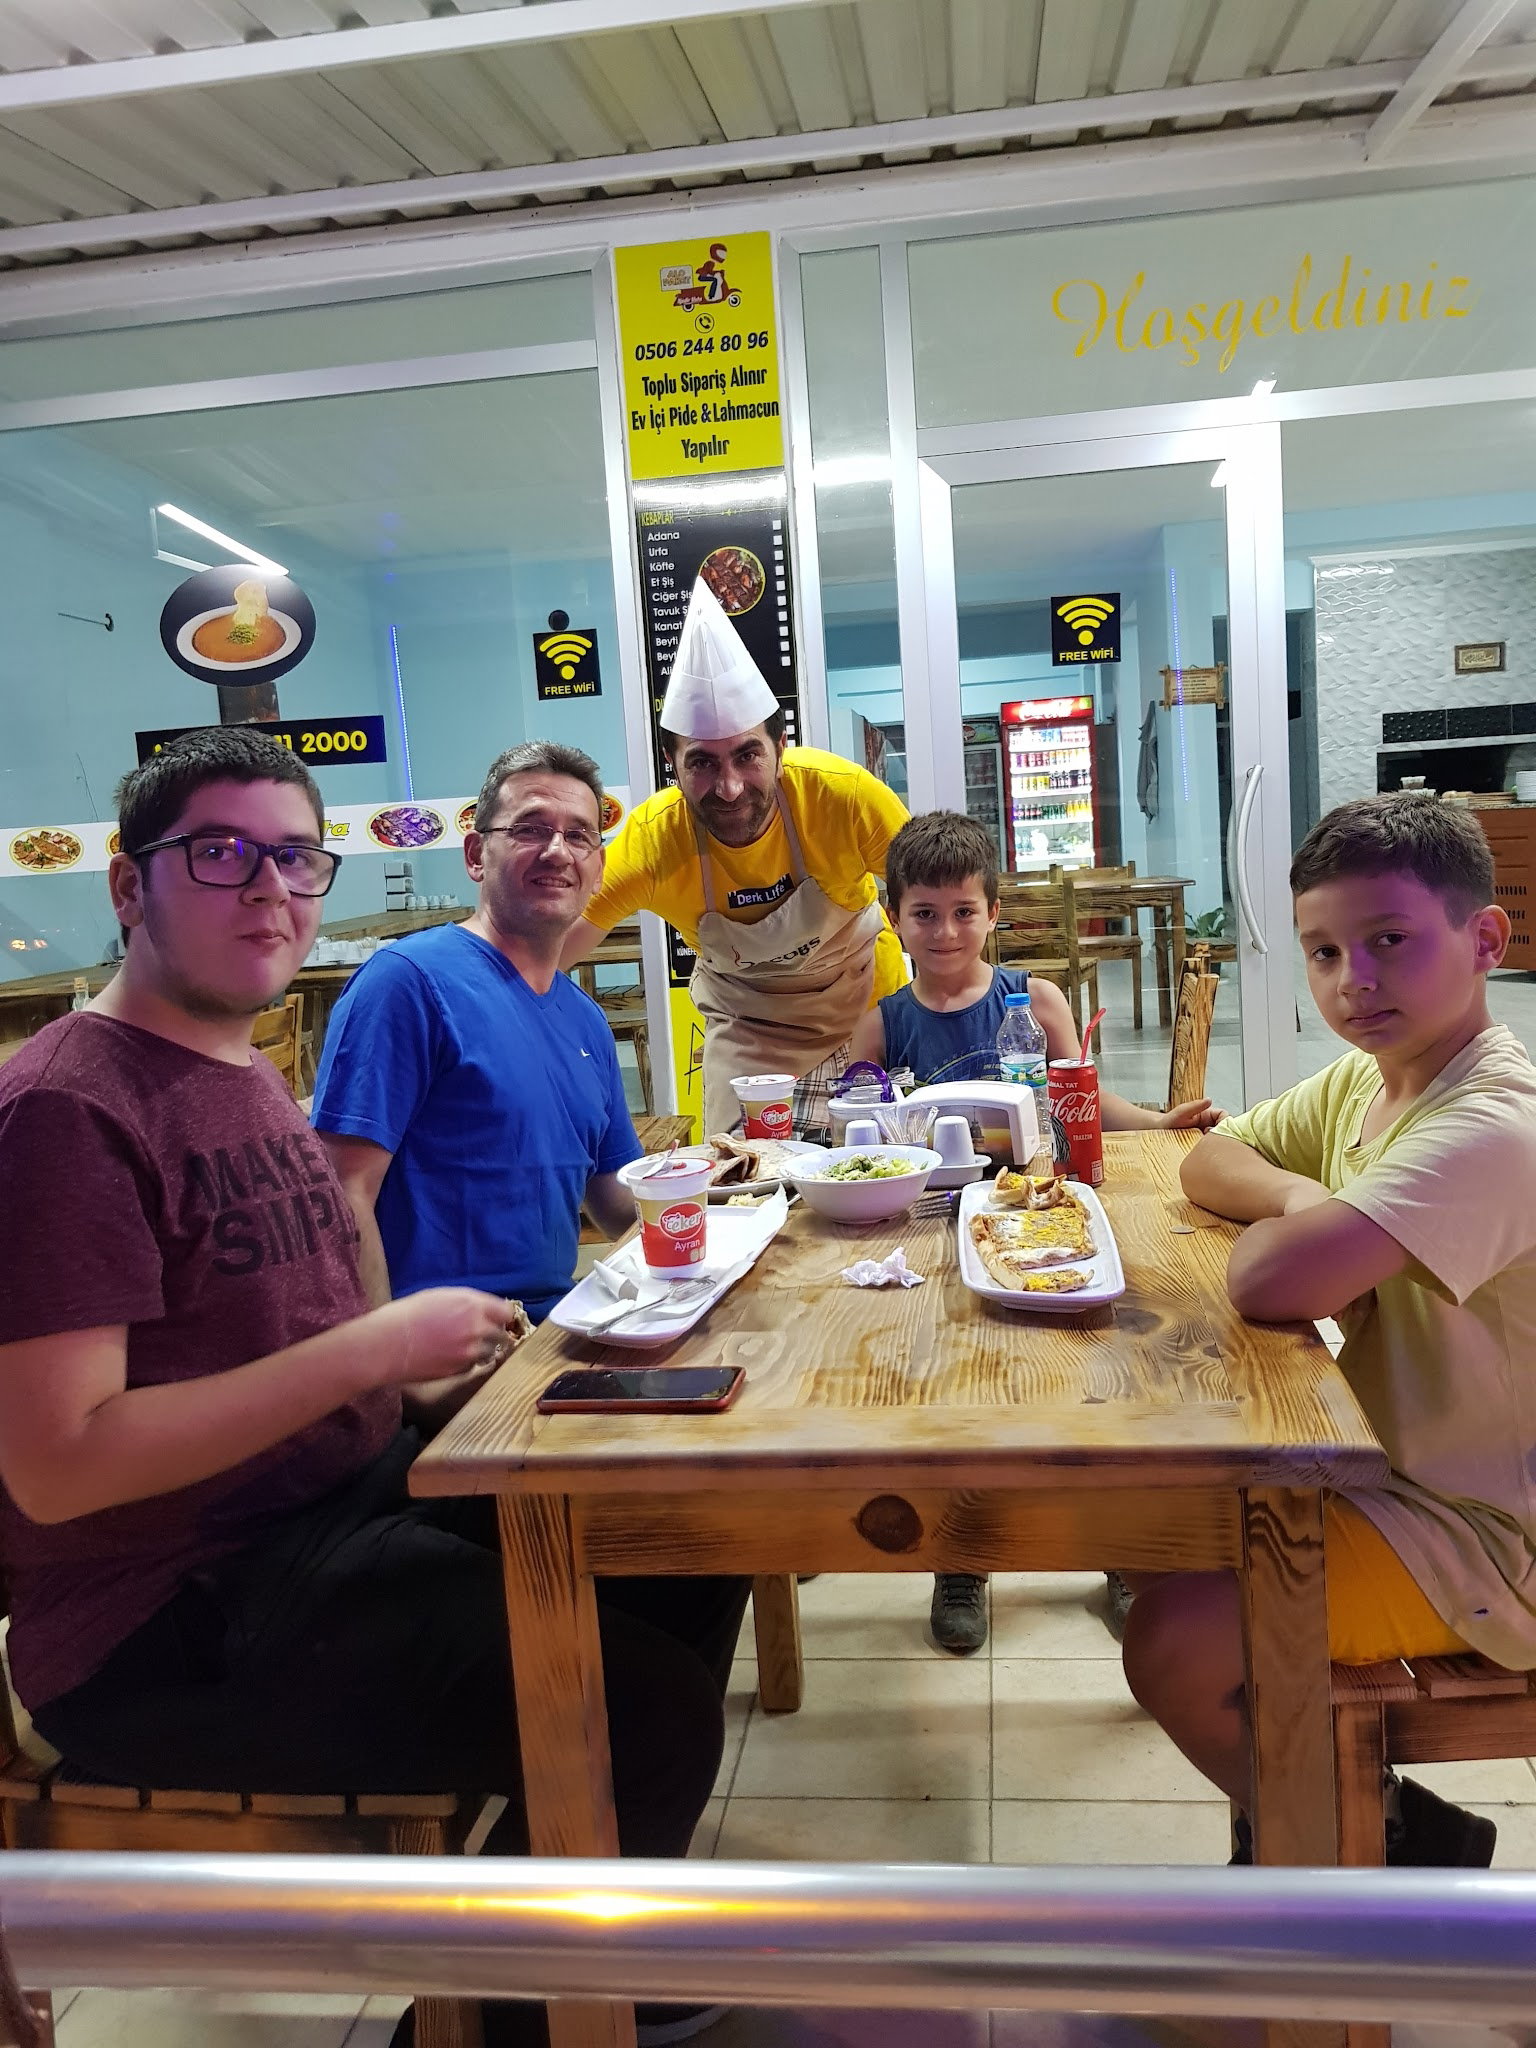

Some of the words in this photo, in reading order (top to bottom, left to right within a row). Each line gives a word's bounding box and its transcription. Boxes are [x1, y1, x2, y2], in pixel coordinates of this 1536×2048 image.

[1051, 252, 1482, 373] Hoşgeldiniz
[635, 341, 677, 361] 0506
[683, 337, 714, 356] 244
[720, 334, 742, 351] 80
[747, 331, 769, 349] 96
[642, 373, 677, 401] Toplu
[681, 369, 726, 397] Sipariş
[731, 365, 767, 387] Alınır
[632, 411, 646, 431] Ev
[650, 404, 665, 435] İçi
[670, 404, 697, 427] Pide
[713, 399, 780, 421] Lahmacun
[681, 434, 730, 463] Yapılır
[641, 510, 674, 527] KEBAPLAR
[647, 531, 680, 542] Adana
[648, 547, 669, 557] Urfa
[649, 561, 675, 572] Köfte
[651, 577, 660, 587] Et
[661, 576, 675, 589] Şiş
[652, 592, 679, 603] Ciğer
[653, 606, 680, 617] Tavuk
[654, 620, 683, 632] Kanat
[655, 635, 679, 647] Beyti
[656, 650, 678, 662] Beyt
[1060, 651, 1088, 661] FREE
[544, 685, 571, 695] FREE
[301, 730, 368, 754] 2000
[182, 1134, 331, 1212] MAKE
[674, 1239, 700, 1253] Ayran
